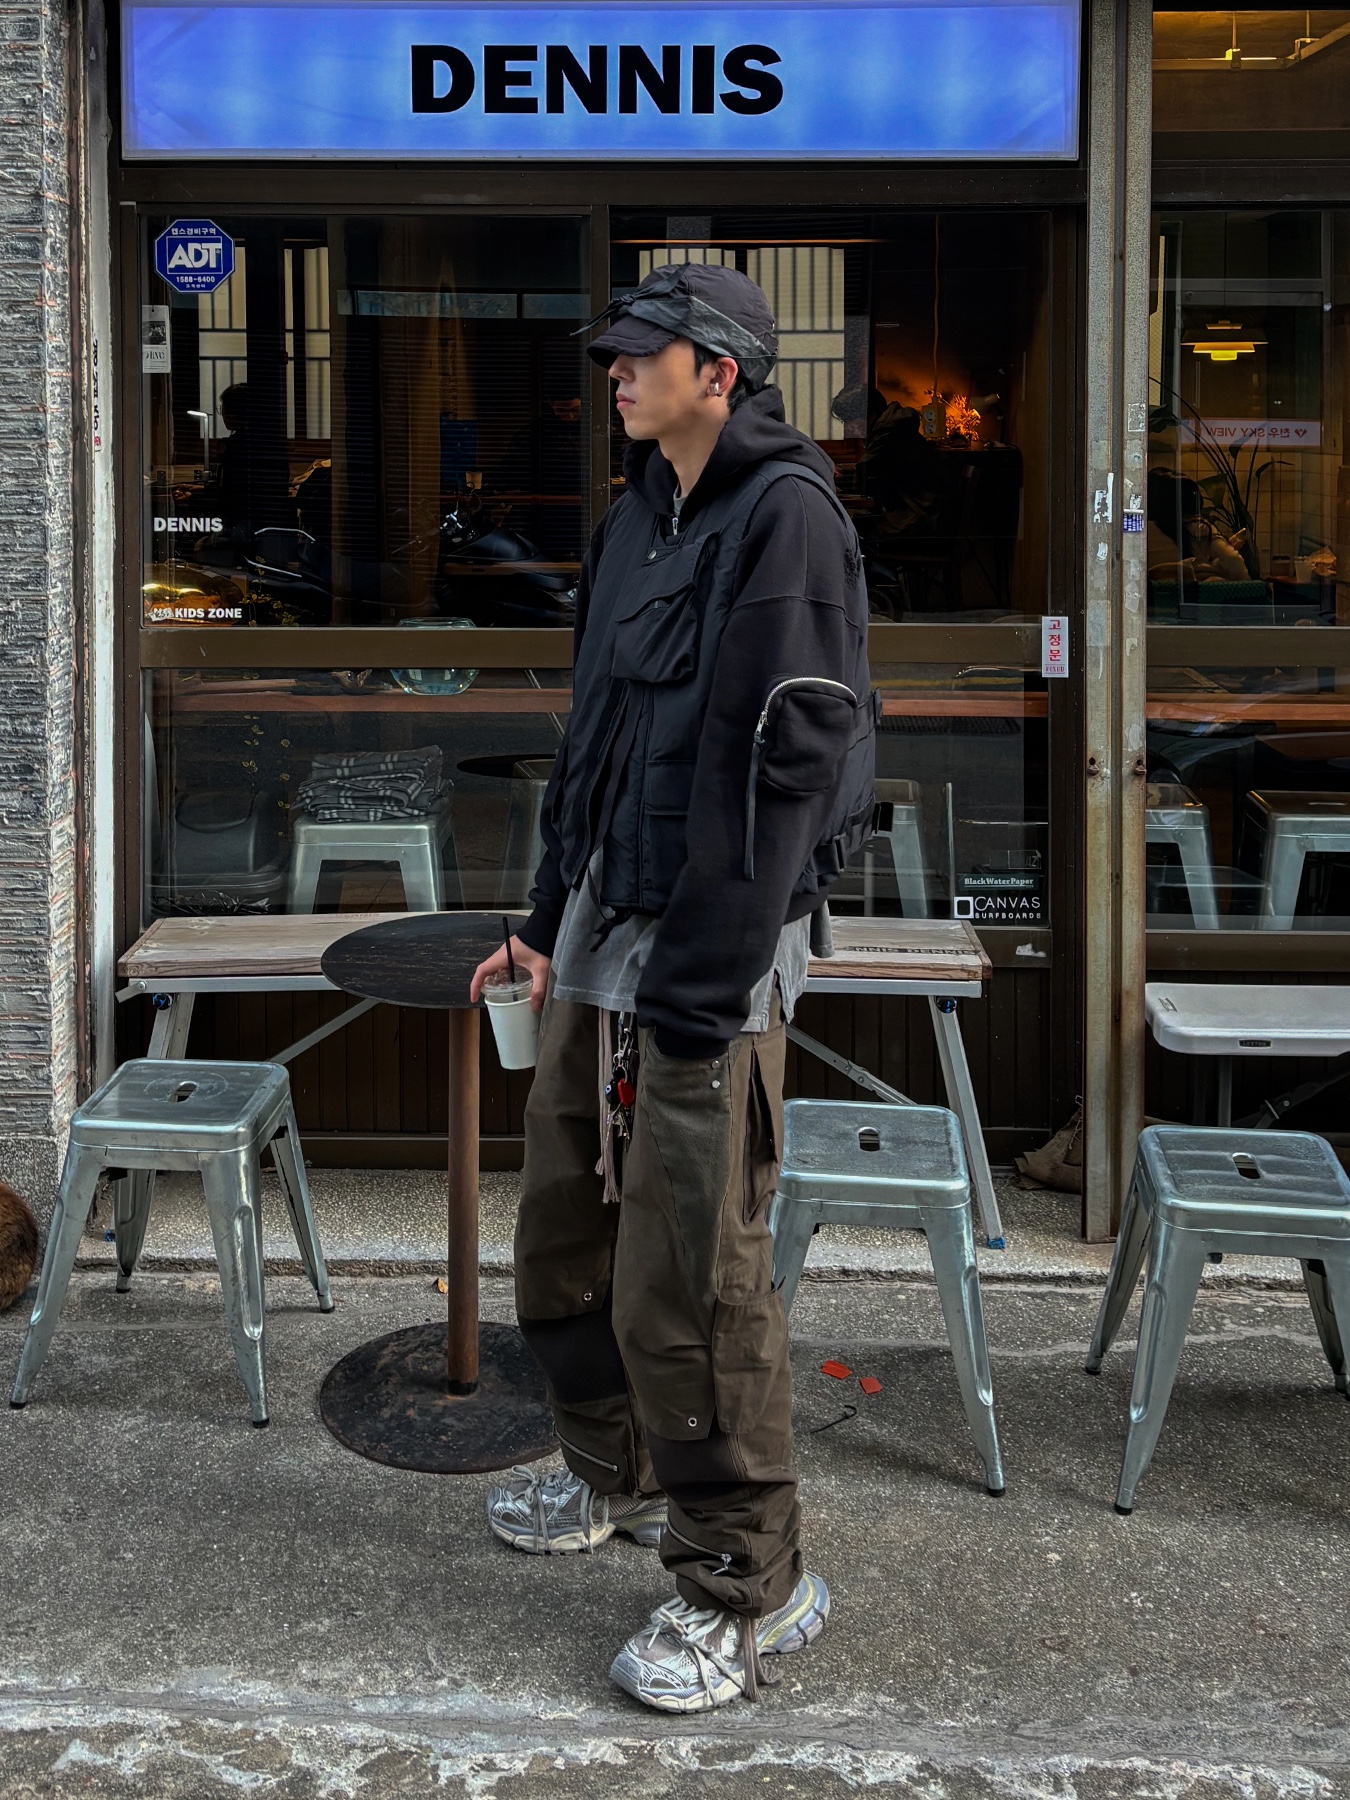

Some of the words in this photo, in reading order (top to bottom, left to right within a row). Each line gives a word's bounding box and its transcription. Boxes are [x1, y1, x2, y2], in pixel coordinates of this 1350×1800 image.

[410, 44, 784, 116] DENNIS
[168, 242, 222, 268] ADT
[153, 517, 223, 532] DENNIS
[175, 608, 205, 618] KIDS
[208, 608, 242, 618] ZONE
[1049, 619, 1061, 662] 고정문
[964, 878, 1034, 886] BlackWaterPaper
[974, 897, 1041, 911] CANVAS
